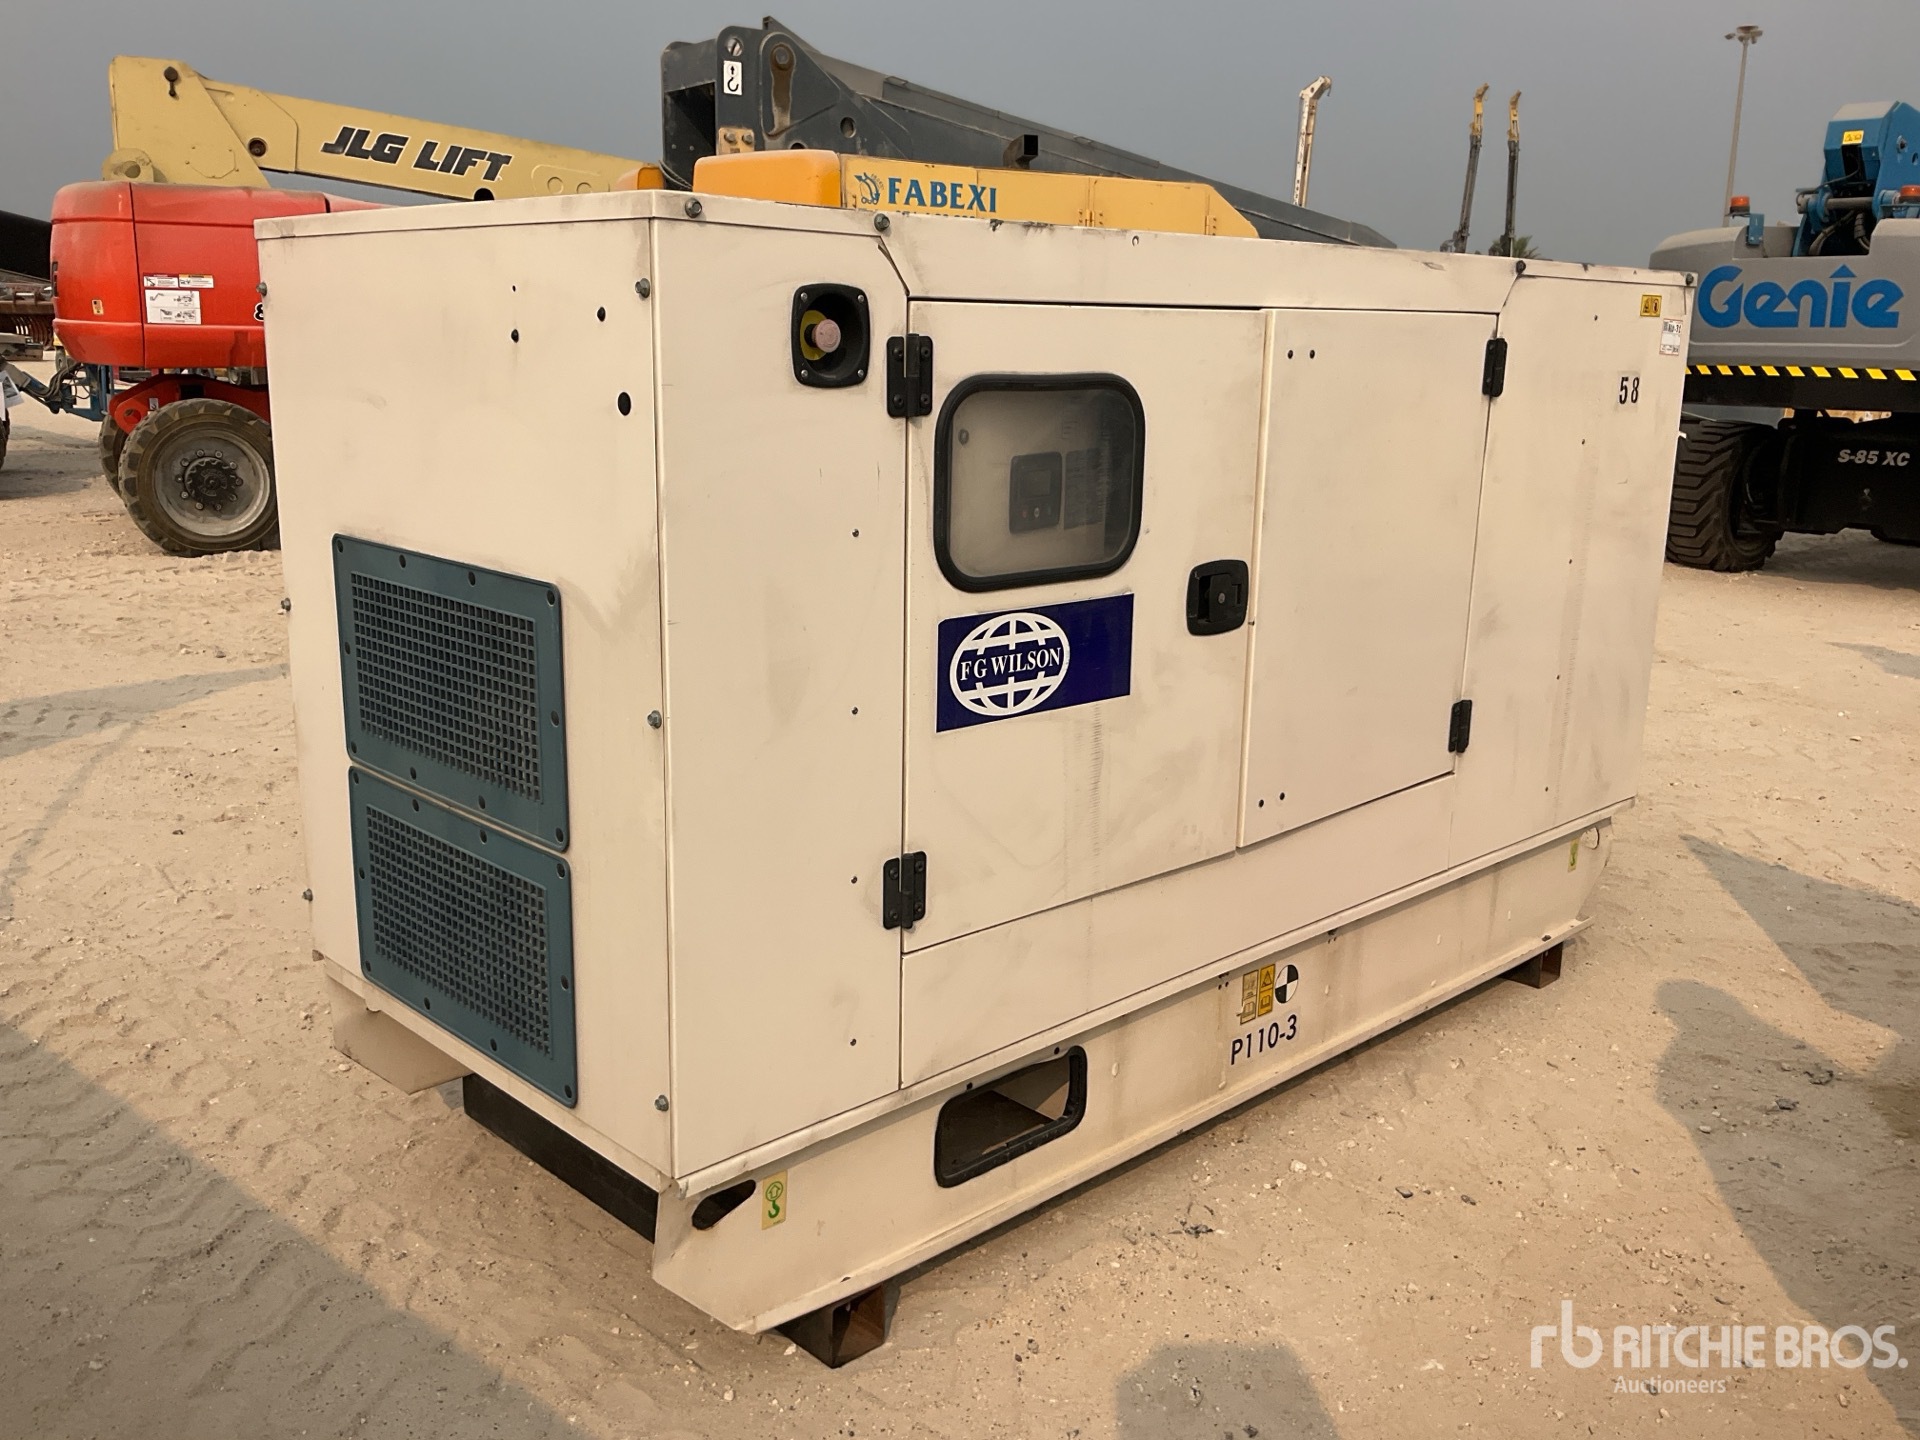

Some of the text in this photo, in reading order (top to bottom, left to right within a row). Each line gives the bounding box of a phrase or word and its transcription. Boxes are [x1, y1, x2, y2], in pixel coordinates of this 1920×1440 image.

[320, 126, 513, 182] JLG LIFT
[888, 177, 997, 213] FABEXI
[1619, 376, 1640, 405] 58
[1837, 448, 1911, 467] S-85 XC
[960, 647, 1061, 681] FG WILSON
[1230, 1014, 1297, 1066] P110-3
